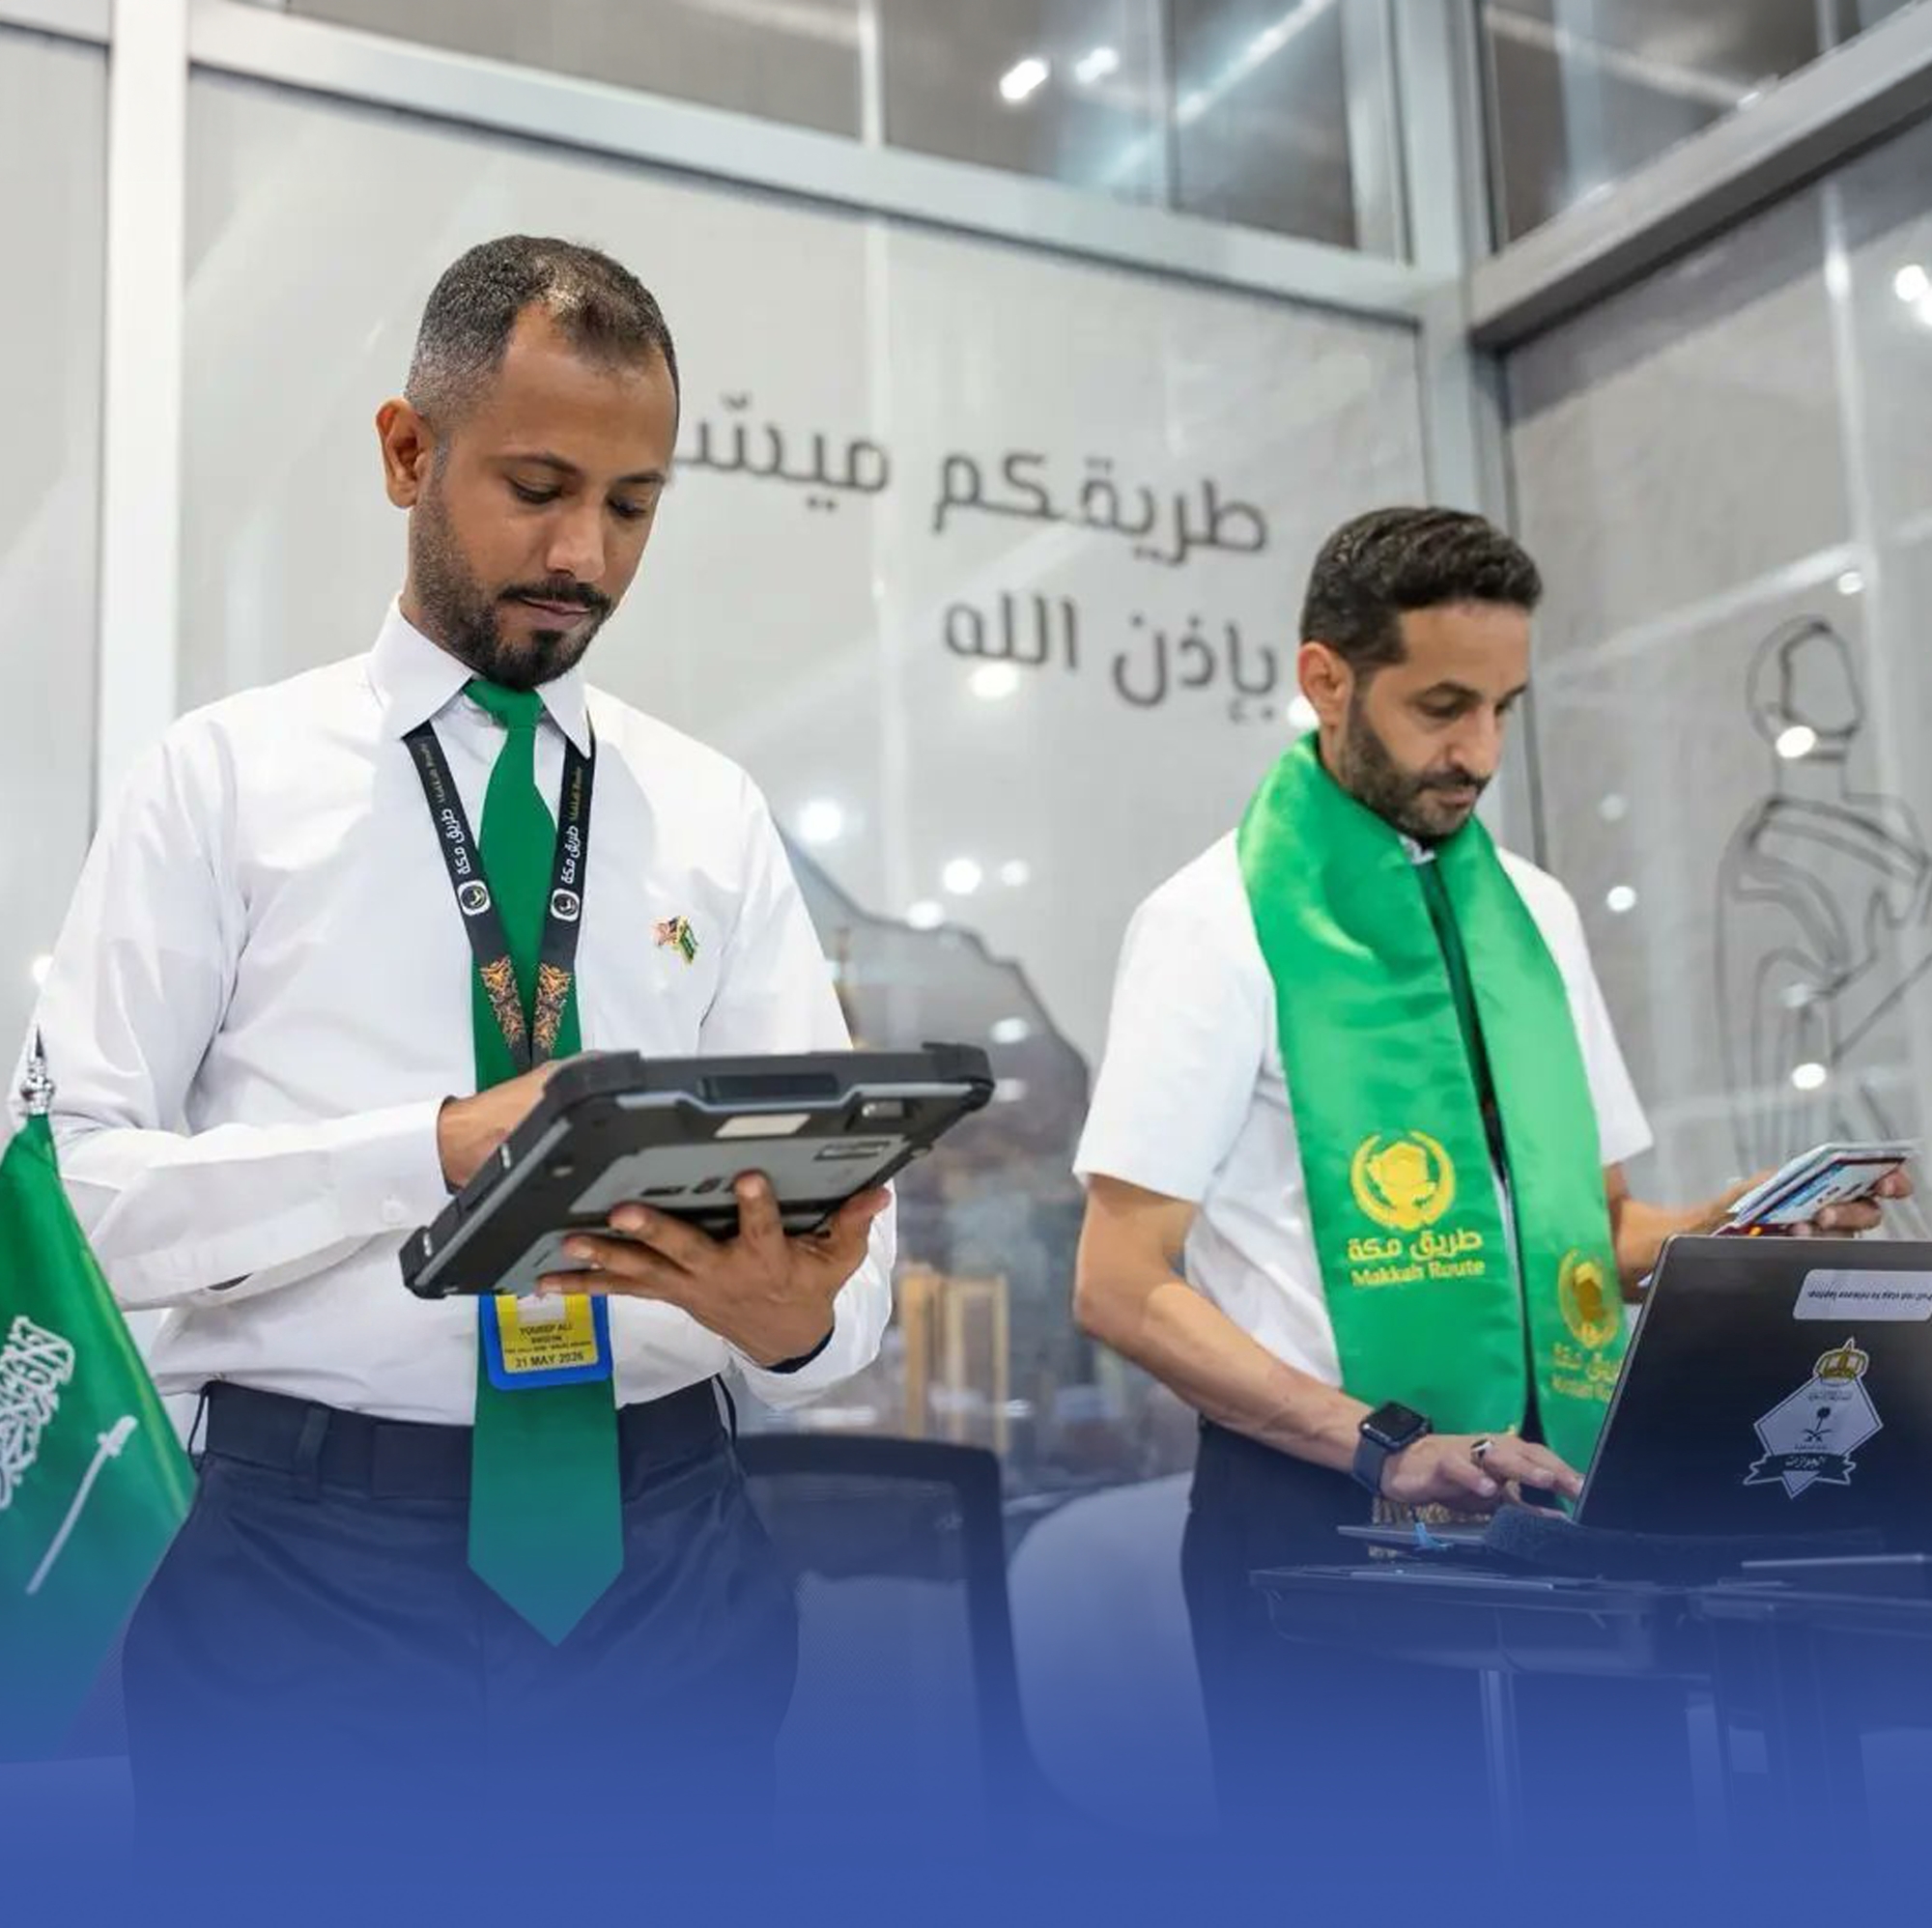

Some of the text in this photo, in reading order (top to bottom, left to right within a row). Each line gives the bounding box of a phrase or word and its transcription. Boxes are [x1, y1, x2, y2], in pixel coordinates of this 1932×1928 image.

[672, 391, 1267, 566] طريقكم ميسّ
[944, 590, 1277, 723] بإذن الله
[440, 808, 471, 875] طريق مكة
[564, 825, 581, 858] طريق
[560, 858, 576, 884] مكة
[1347, 1227, 1484, 1262] طريق مكة
[530, 1354, 556, 1367] MAY
